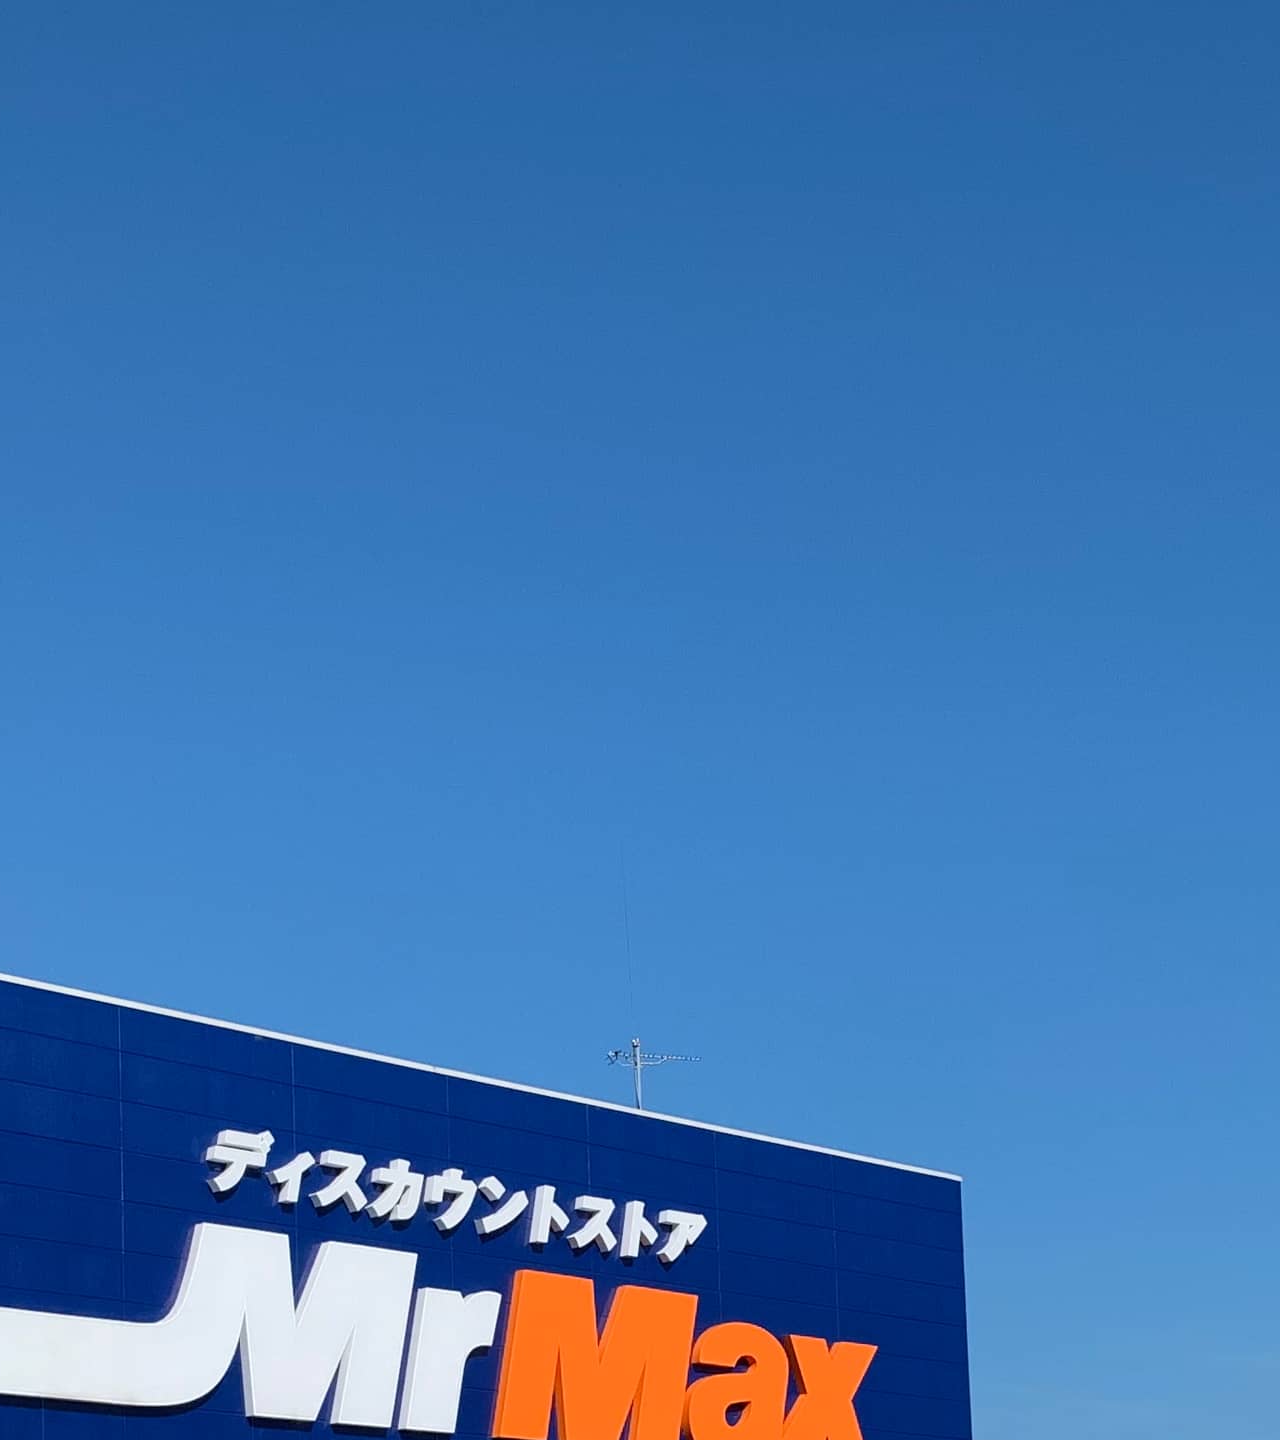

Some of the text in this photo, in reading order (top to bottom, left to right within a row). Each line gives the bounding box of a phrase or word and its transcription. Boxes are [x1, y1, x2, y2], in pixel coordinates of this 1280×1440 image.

[206, 1129, 708, 1263] ディスカウントストア
